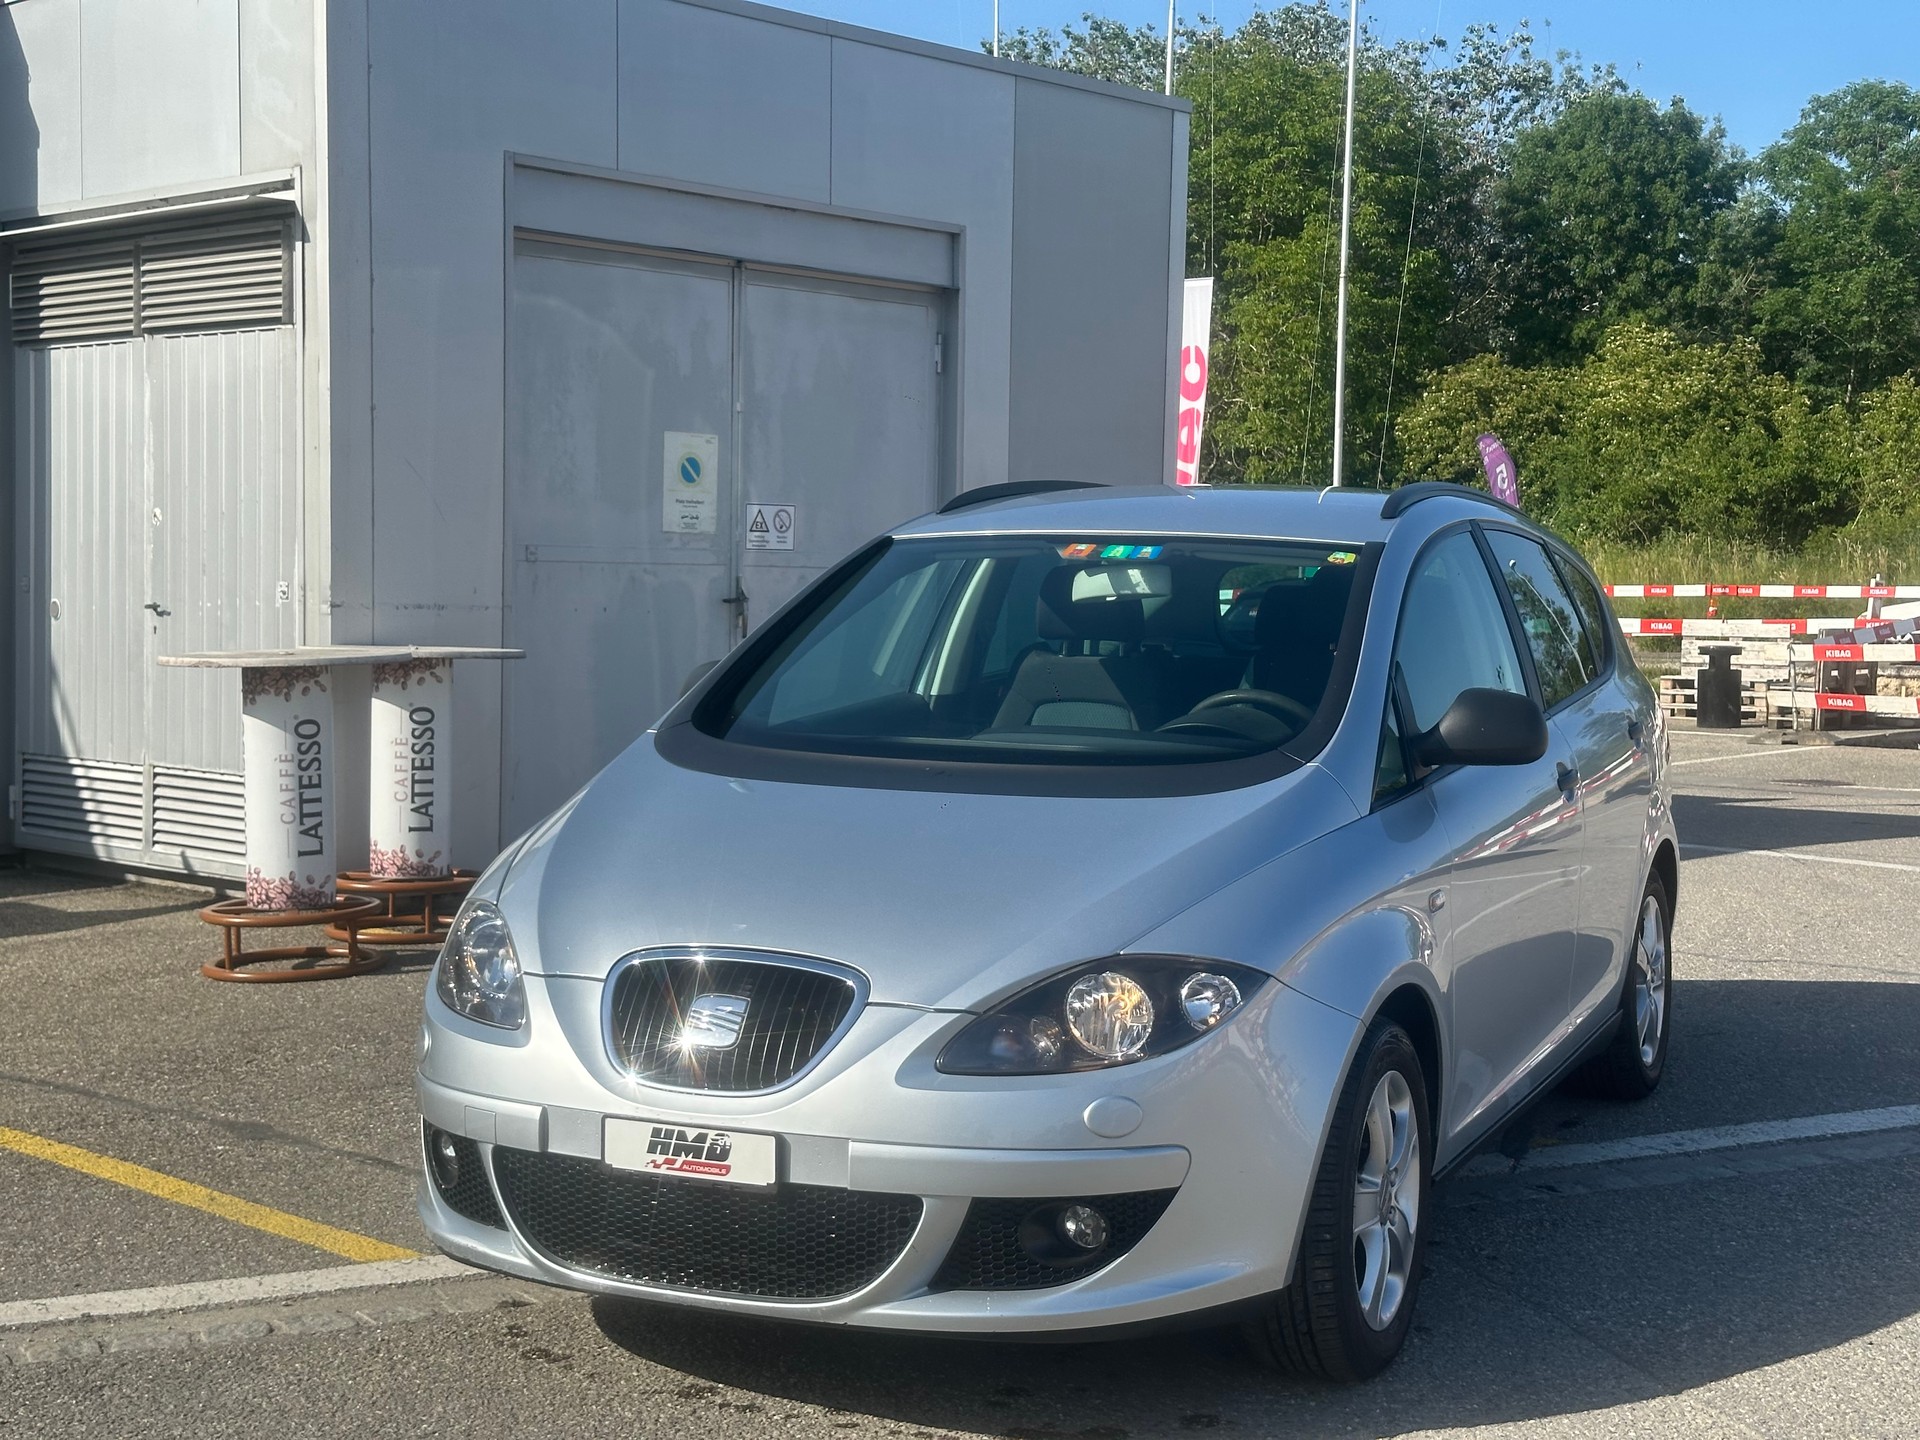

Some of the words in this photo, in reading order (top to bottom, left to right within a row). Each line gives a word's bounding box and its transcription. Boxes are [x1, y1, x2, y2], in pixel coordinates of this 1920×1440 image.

[755, 521, 763, 529] EX
[1650, 622, 1672, 630] KIBAG
[1825, 649, 1851, 658] KIBAG
[1827, 698, 1853, 707] KIBAG
[390, 737, 409, 802] CAFFÈ
[408, 706, 436, 833] LATTESSO
[274, 753, 296, 824] CAFFÈ
[294, 718, 324, 858] LATTESSO
[682, 1164, 727, 1175] AUTOMOBILE
